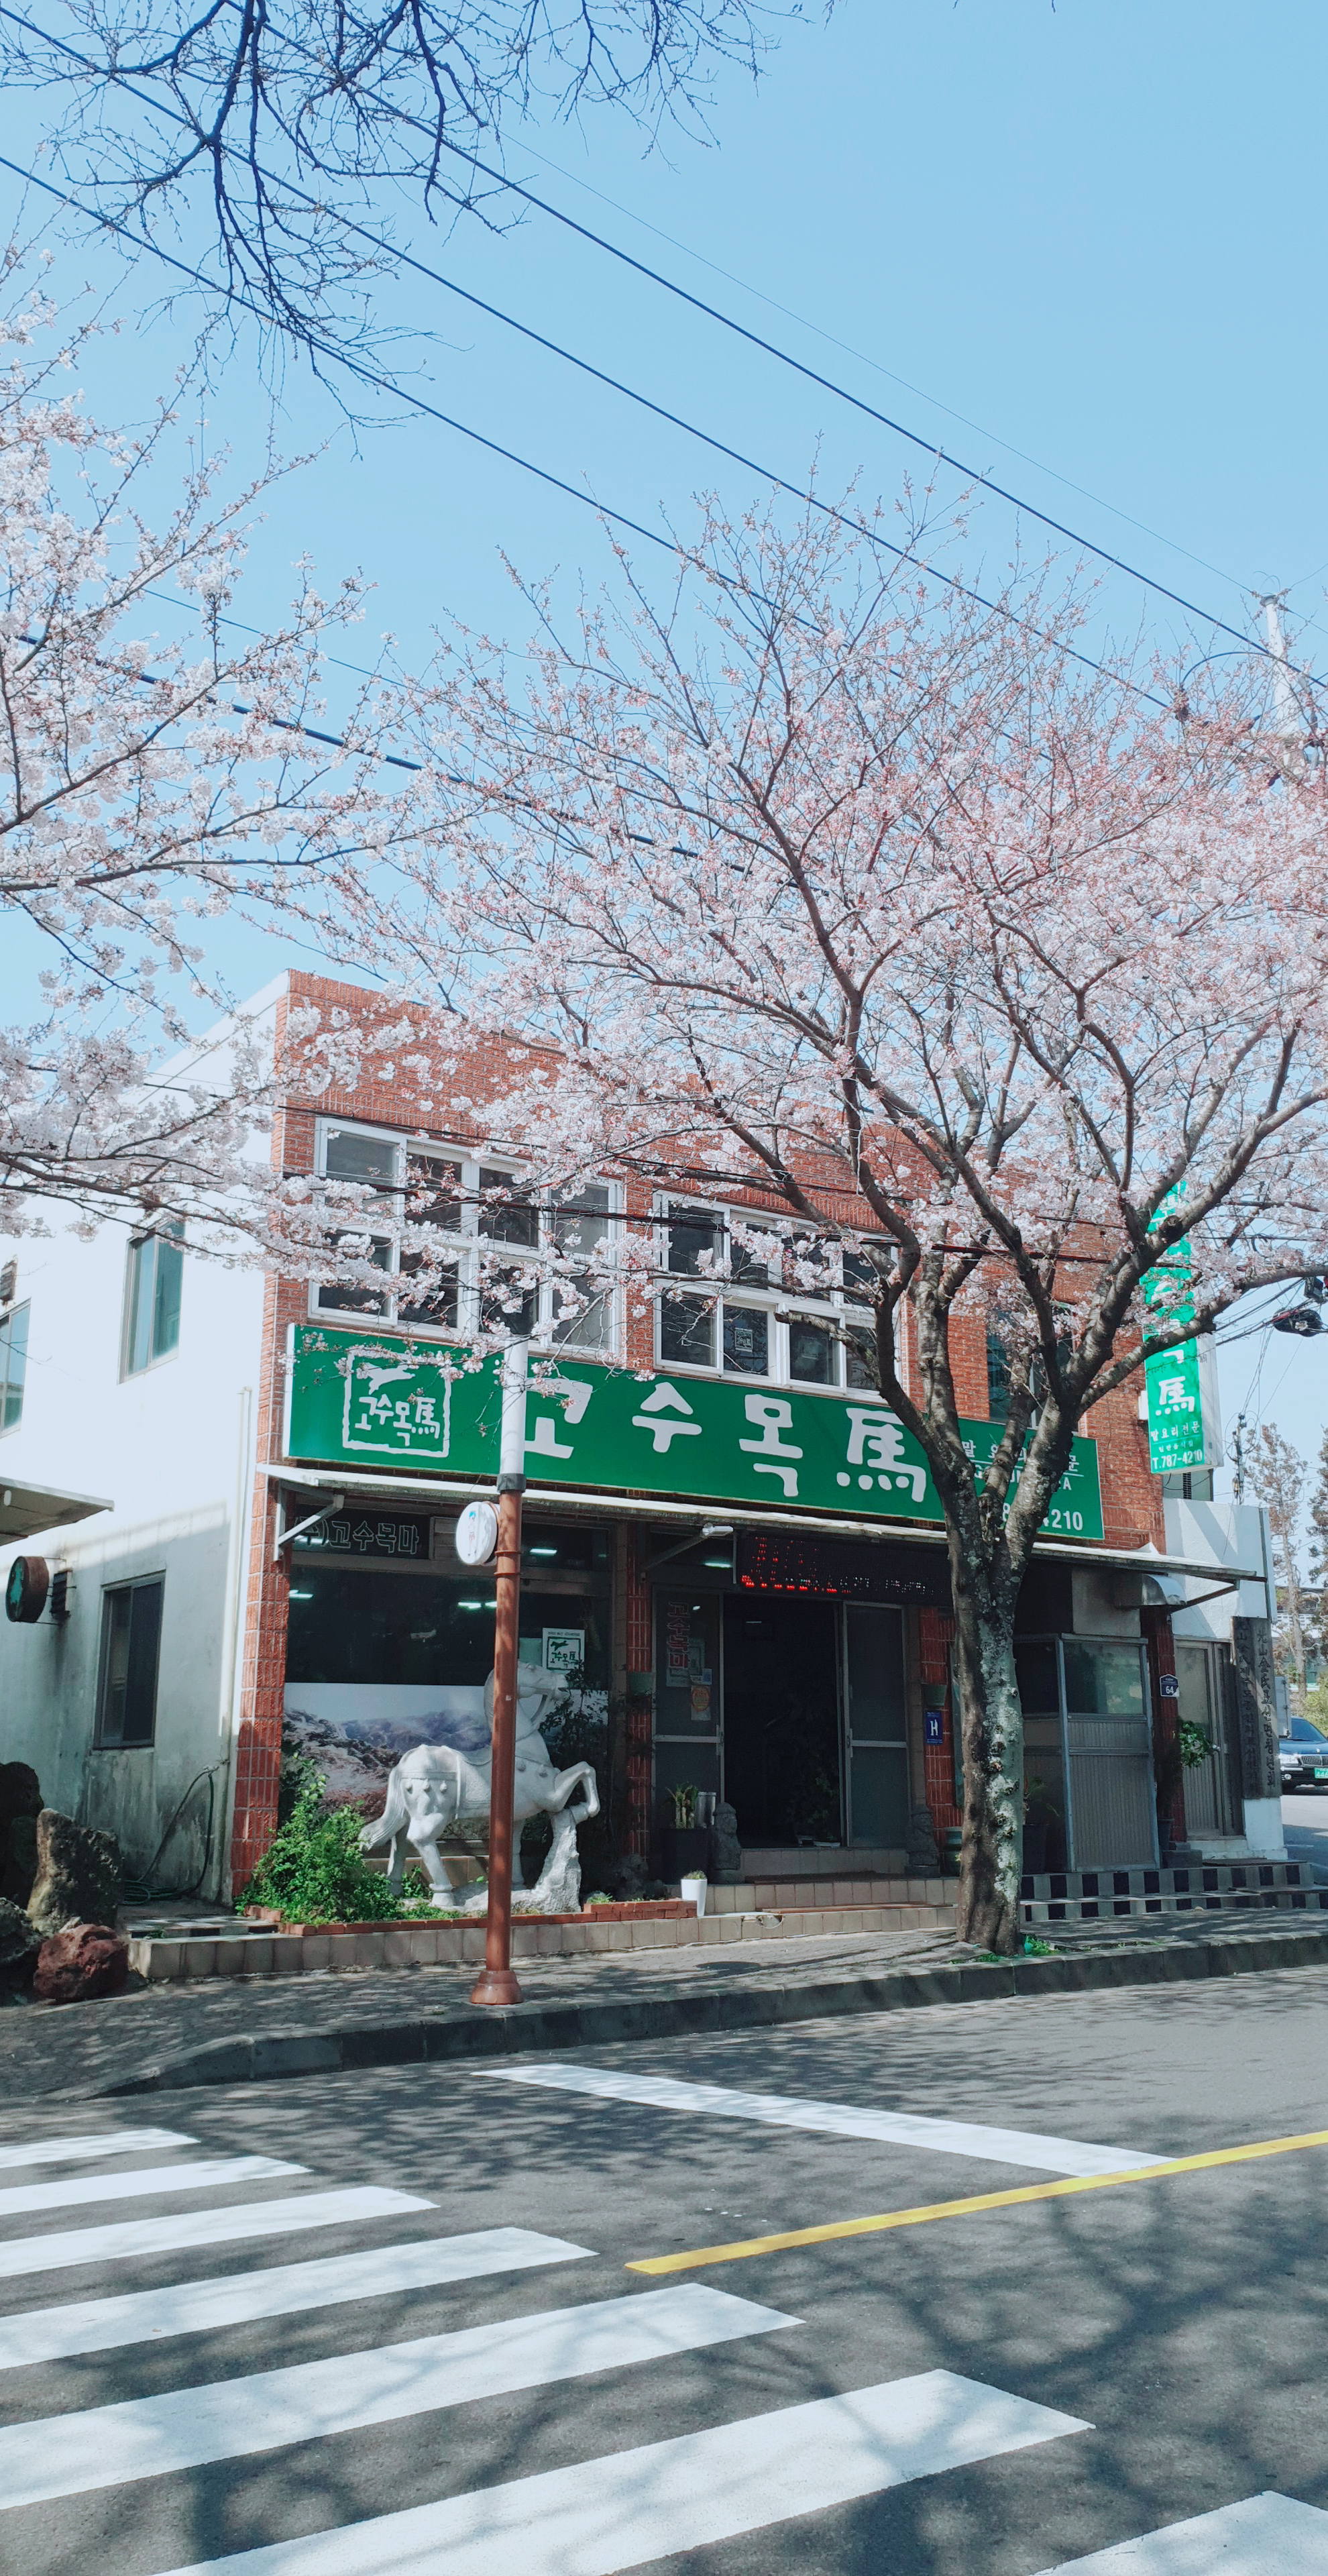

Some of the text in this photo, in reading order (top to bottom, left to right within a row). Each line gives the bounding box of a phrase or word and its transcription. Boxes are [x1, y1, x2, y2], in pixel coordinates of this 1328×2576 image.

[355, 1393, 441, 1446] 고수목馬
[1152, 1449, 1203, 1470] T.787-4210
[1166, 1685, 1174, 1695] 64
